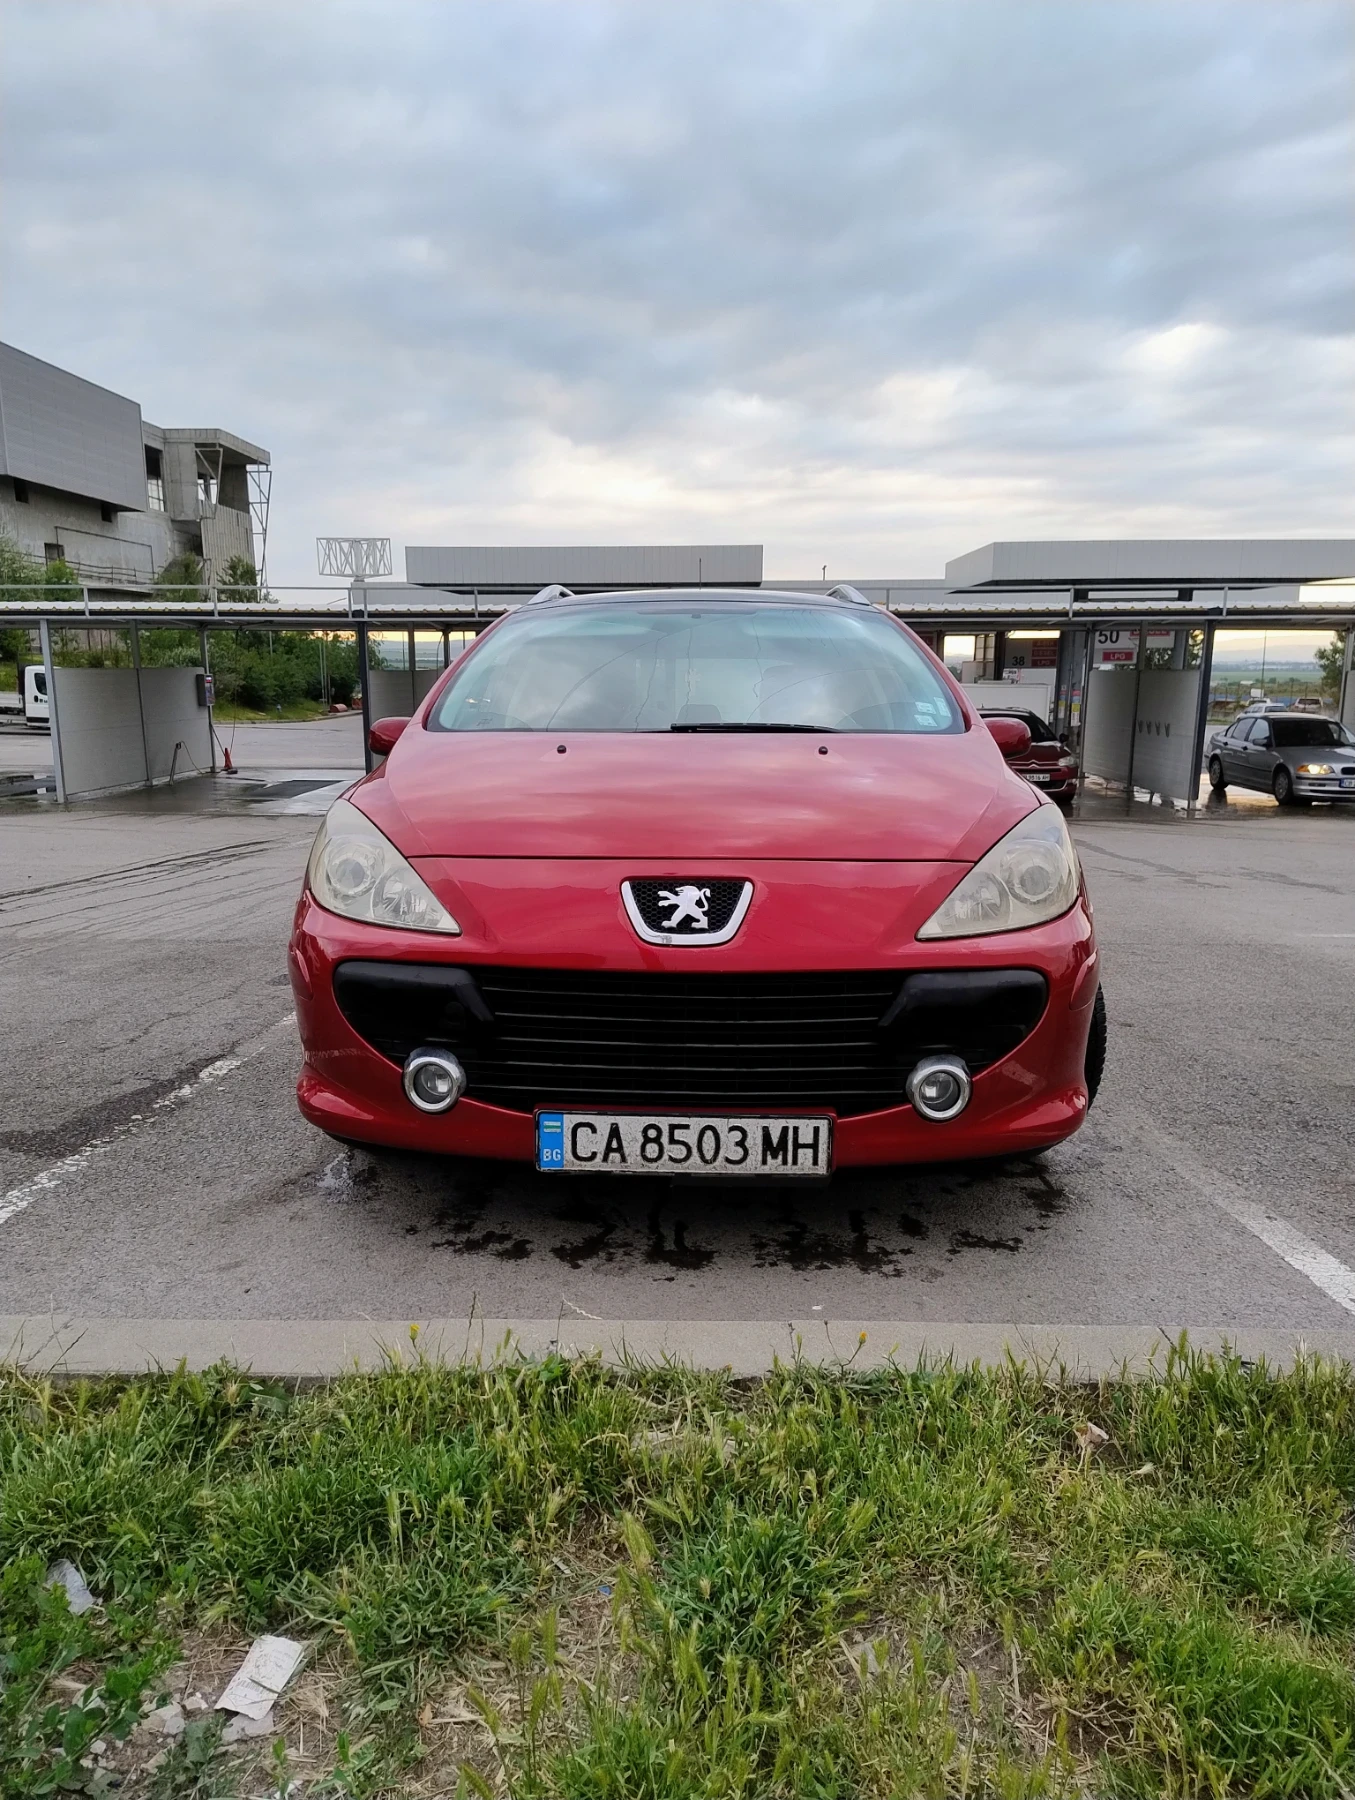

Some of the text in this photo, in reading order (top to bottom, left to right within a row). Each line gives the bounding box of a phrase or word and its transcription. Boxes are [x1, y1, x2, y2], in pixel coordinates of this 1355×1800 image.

[1097, 630, 1120, 644] 50
[1011, 655, 1025, 666] 38
[570, 1121, 820, 1167] CA 8503 MH
[543, 1148, 562, 1162] BG
